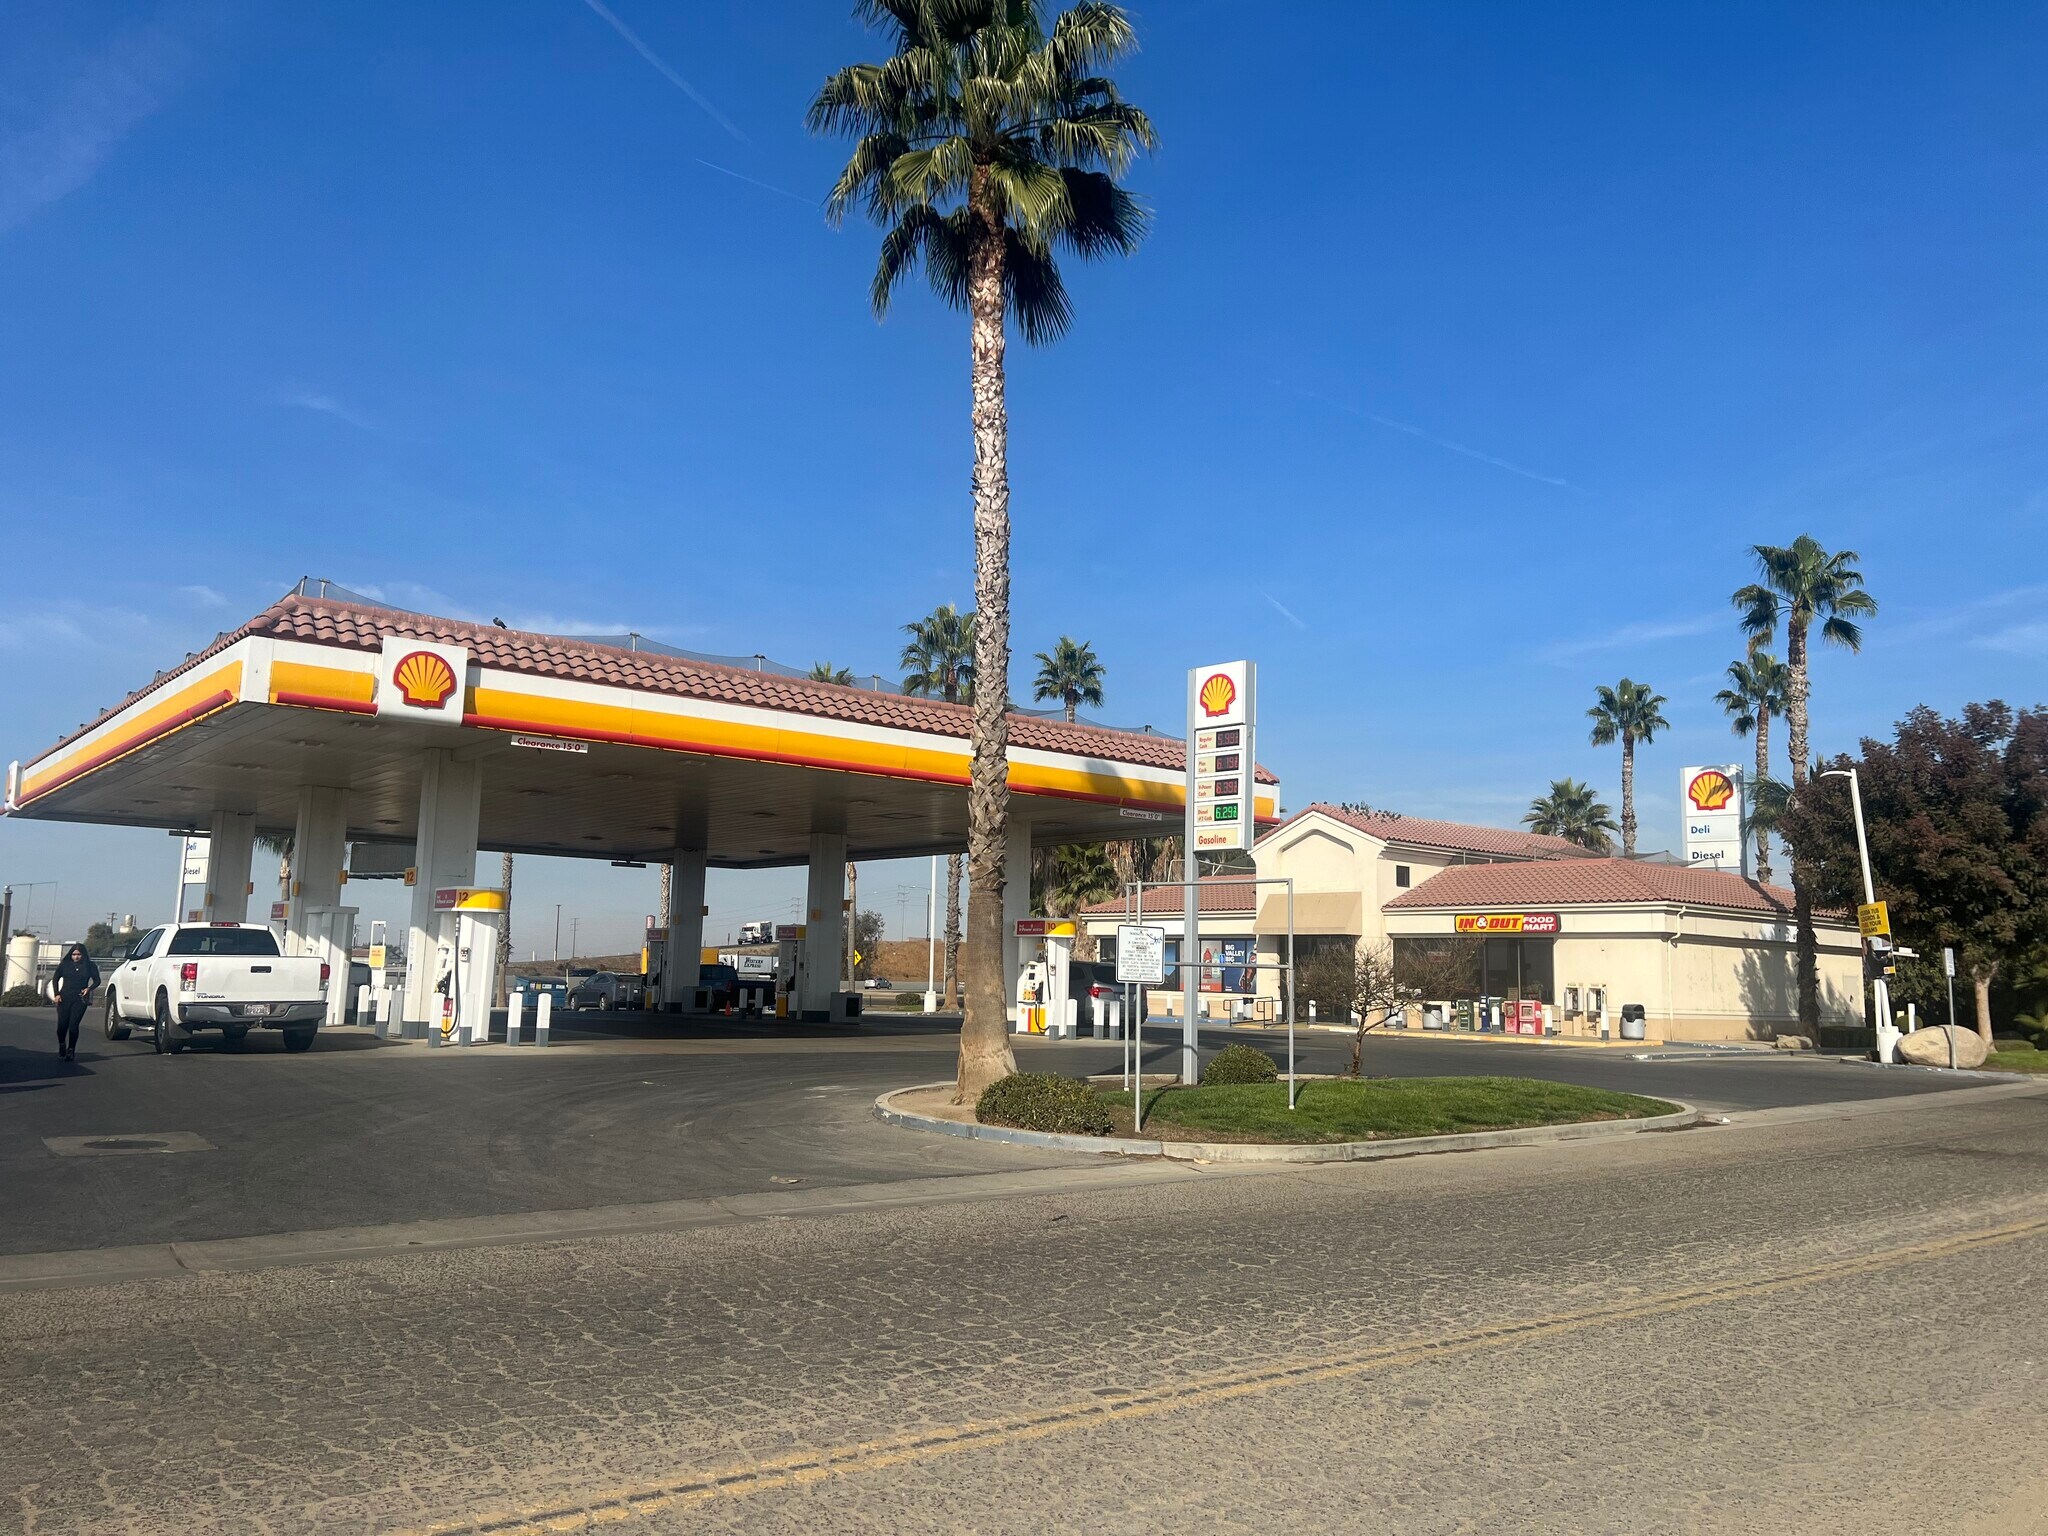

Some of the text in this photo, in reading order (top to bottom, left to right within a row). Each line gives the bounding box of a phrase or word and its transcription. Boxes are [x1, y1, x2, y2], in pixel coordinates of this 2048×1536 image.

[517, 737, 561, 749] Clearance
[1122, 809, 1147, 818] Clearance
[1690, 825, 1710, 834] Deli
[1198, 835, 1227, 845] Gasoline
[1692, 850, 1724, 860] Diesel
[406, 871, 414, 881] 12
[458, 891, 469, 902] 12
[1047, 922, 1056, 930] 10
[1458, 918, 1475, 929] IN
[1488, 918, 1521, 929] OUT
